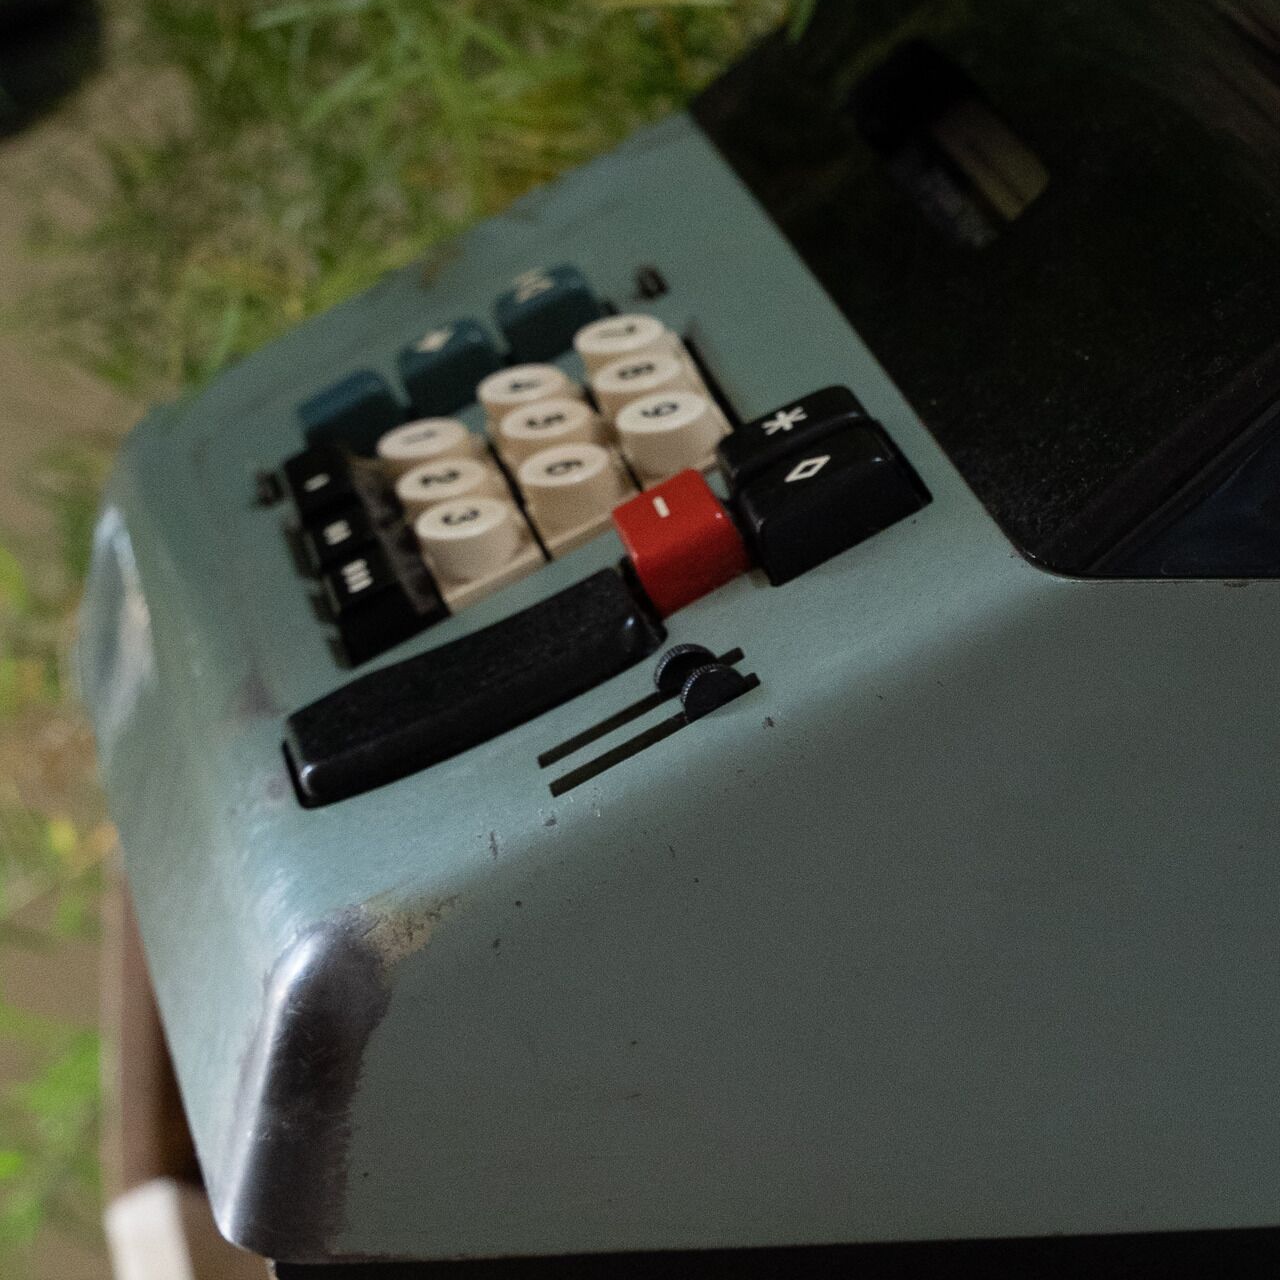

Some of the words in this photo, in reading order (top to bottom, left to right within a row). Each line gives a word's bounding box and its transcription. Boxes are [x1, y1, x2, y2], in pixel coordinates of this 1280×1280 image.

[617, 361, 656, 381] 8
[640, 400, 680, 419] 9
[525, 411, 566, 431] 5
[544, 458, 583, 477] 6
[419, 468, 460, 489] 2
[441, 508, 480, 526] 3
